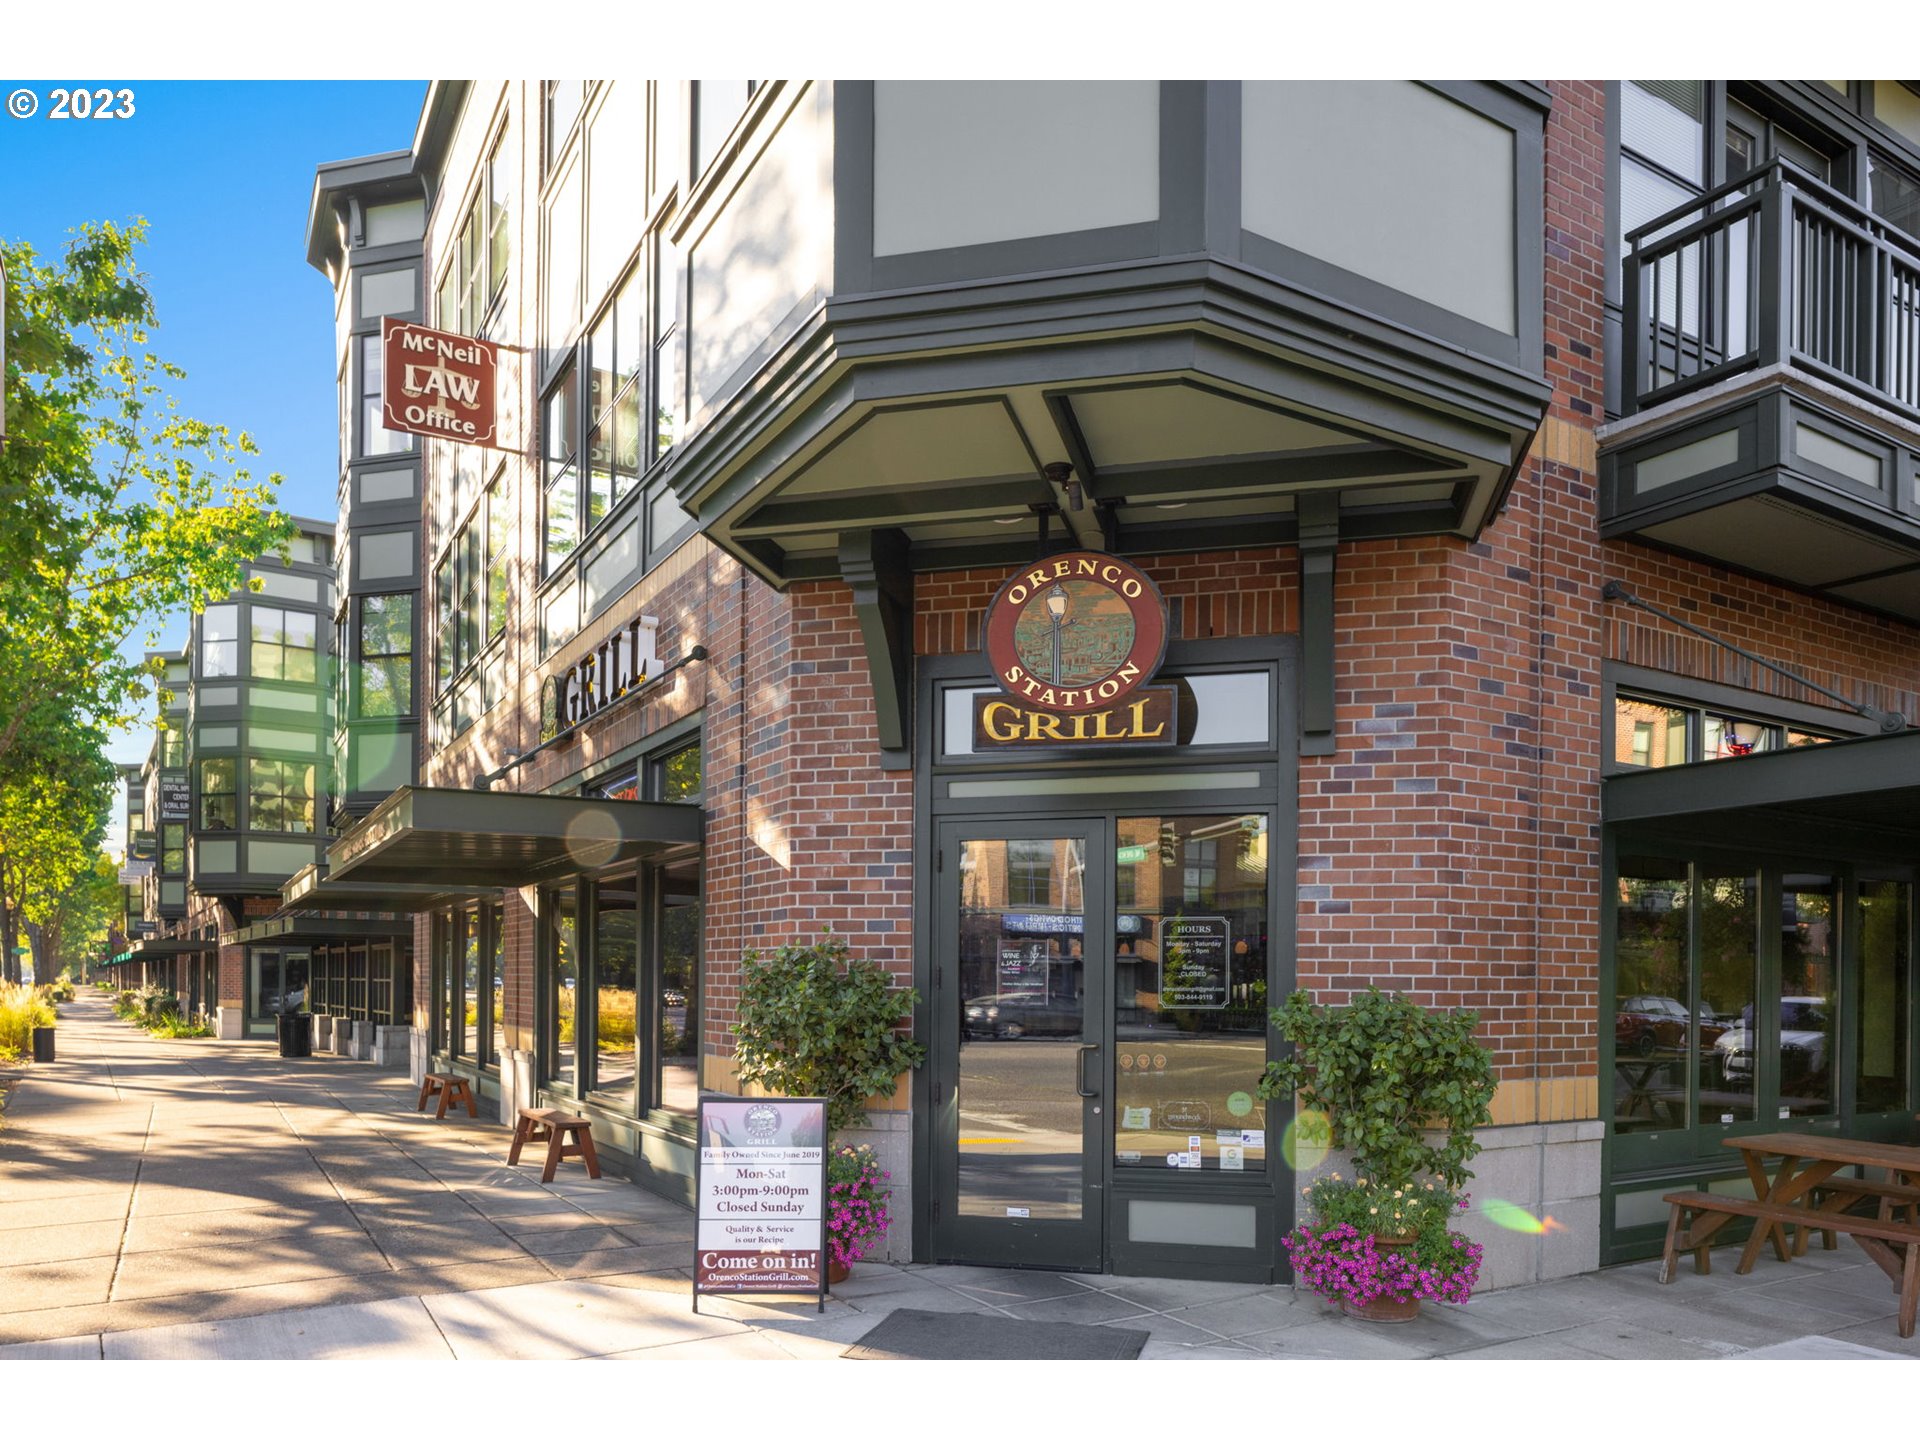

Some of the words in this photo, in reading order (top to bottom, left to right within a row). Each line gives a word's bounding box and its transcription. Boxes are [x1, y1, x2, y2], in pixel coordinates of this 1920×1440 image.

[402, 331, 481, 365] McNeil
[404, 363, 480, 404] LAW
[404, 405, 476, 435] Office
[1008, 559, 1142, 605] ORENCO
[560, 615, 656, 729] GRILL
[1004, 660, 1140, 707] STATION
[982, 697, 1165, 742] GRILL
[1177, 925, 1211, 933] HOURS
[1195, 940, 1221, 948] Saturday
[747, 1104, 778, 1115] ORENCO
[747, 1127, 777, 1137] STATION
[704, 1151, 730, 1159] Family
[732, 1150, 759, 1158] Owned
[761, 1150, 781, 1158] Since
[783, 1151, 800, 1159] June
[736, 1168, 786, 1179] Mon-Sat
[712, 1185, 809, 1198] 3:00pm-9:00pm
[716, 1201, 758, 1212] Closed
[760, 1201, 804, 1215] Sunday
[725, 1225, 754, 1234] Quality
[766, 1225, 794, 1233] Service
[758, 1236, 784, 1245] Recipe
[702, 1252, 758, 1269] Come
[762, 1256, 787, 1269] on
[790, 1252, 816, 1269] in!
[708, 1272, 809, 1281] OrencoStationGrill.com
